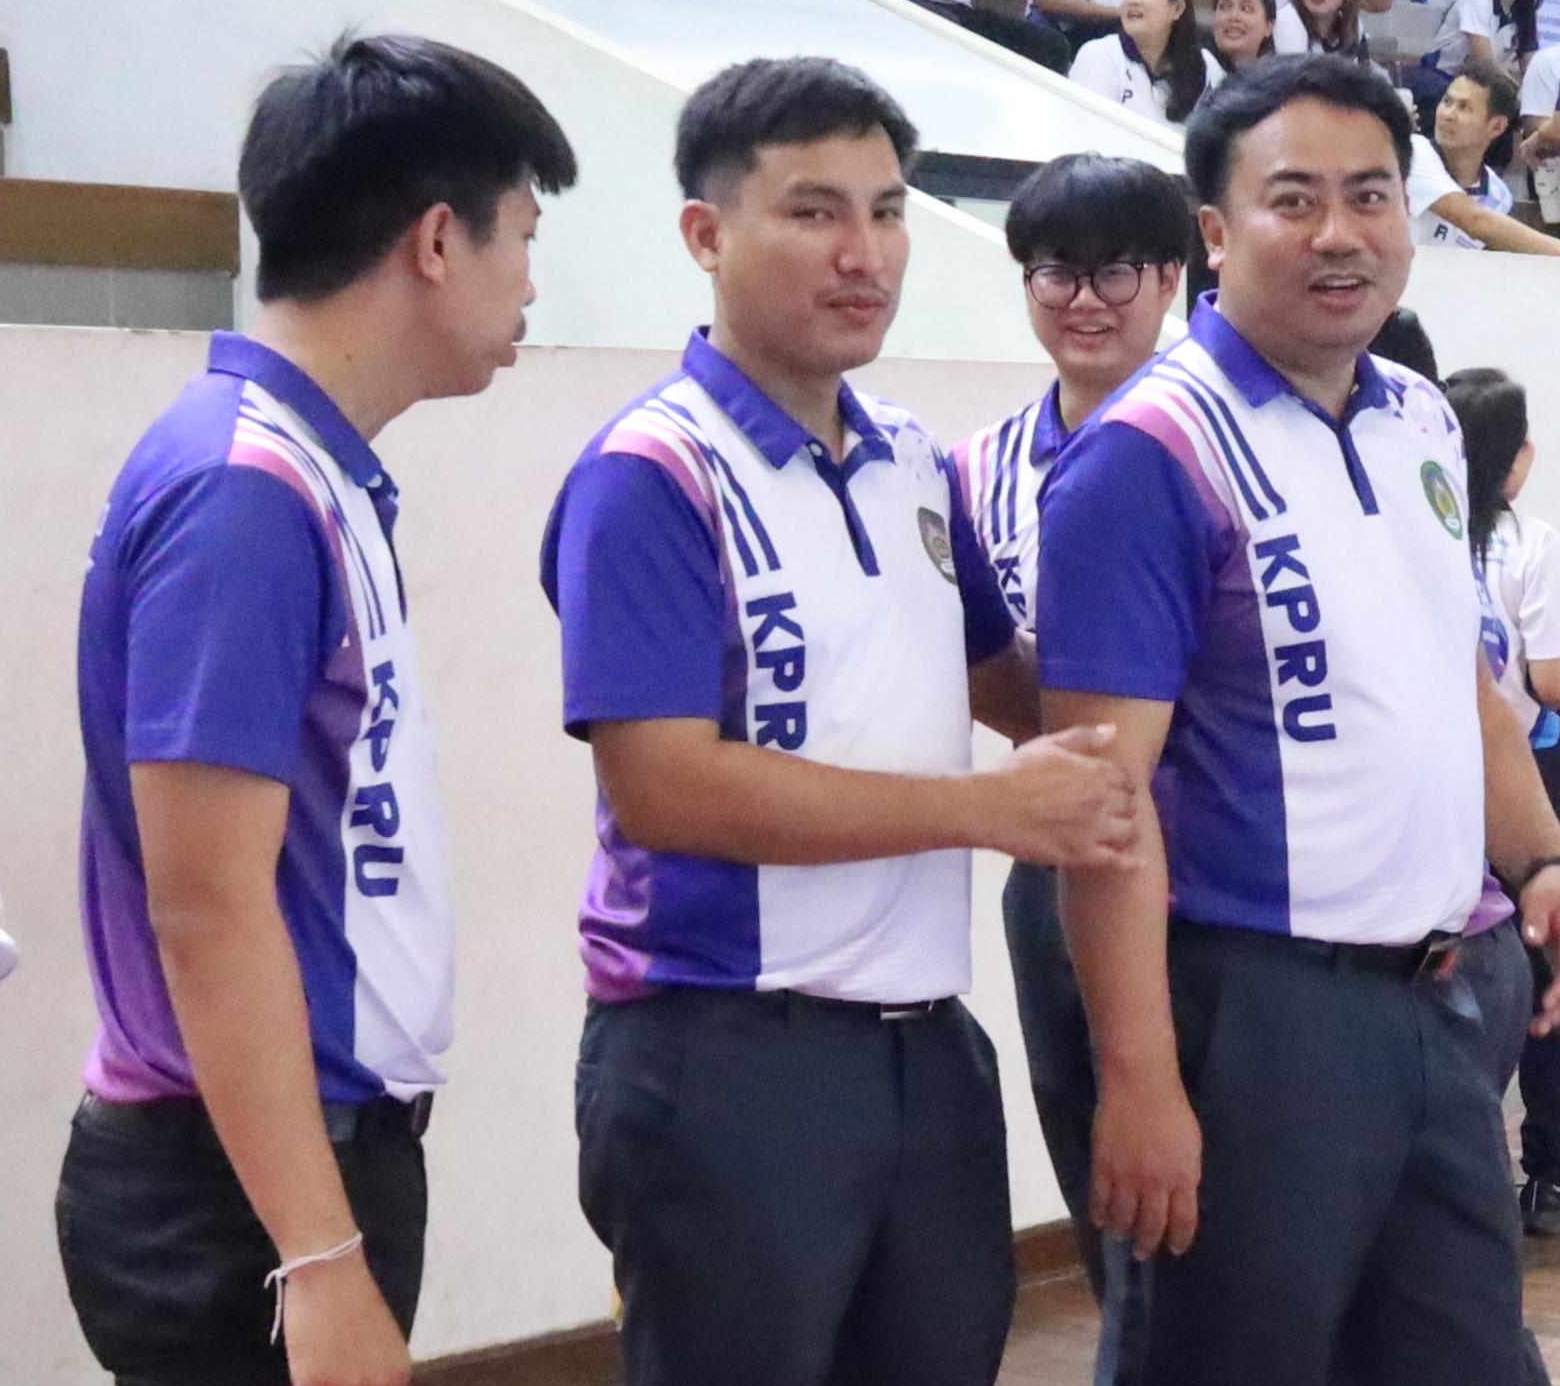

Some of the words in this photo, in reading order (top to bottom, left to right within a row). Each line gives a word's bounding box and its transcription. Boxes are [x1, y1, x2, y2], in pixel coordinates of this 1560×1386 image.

[744, 591, 807, 754] KPR
[1254, 533, 1337, 744] KPRU
[349, 658, 405, 900] KPRU
